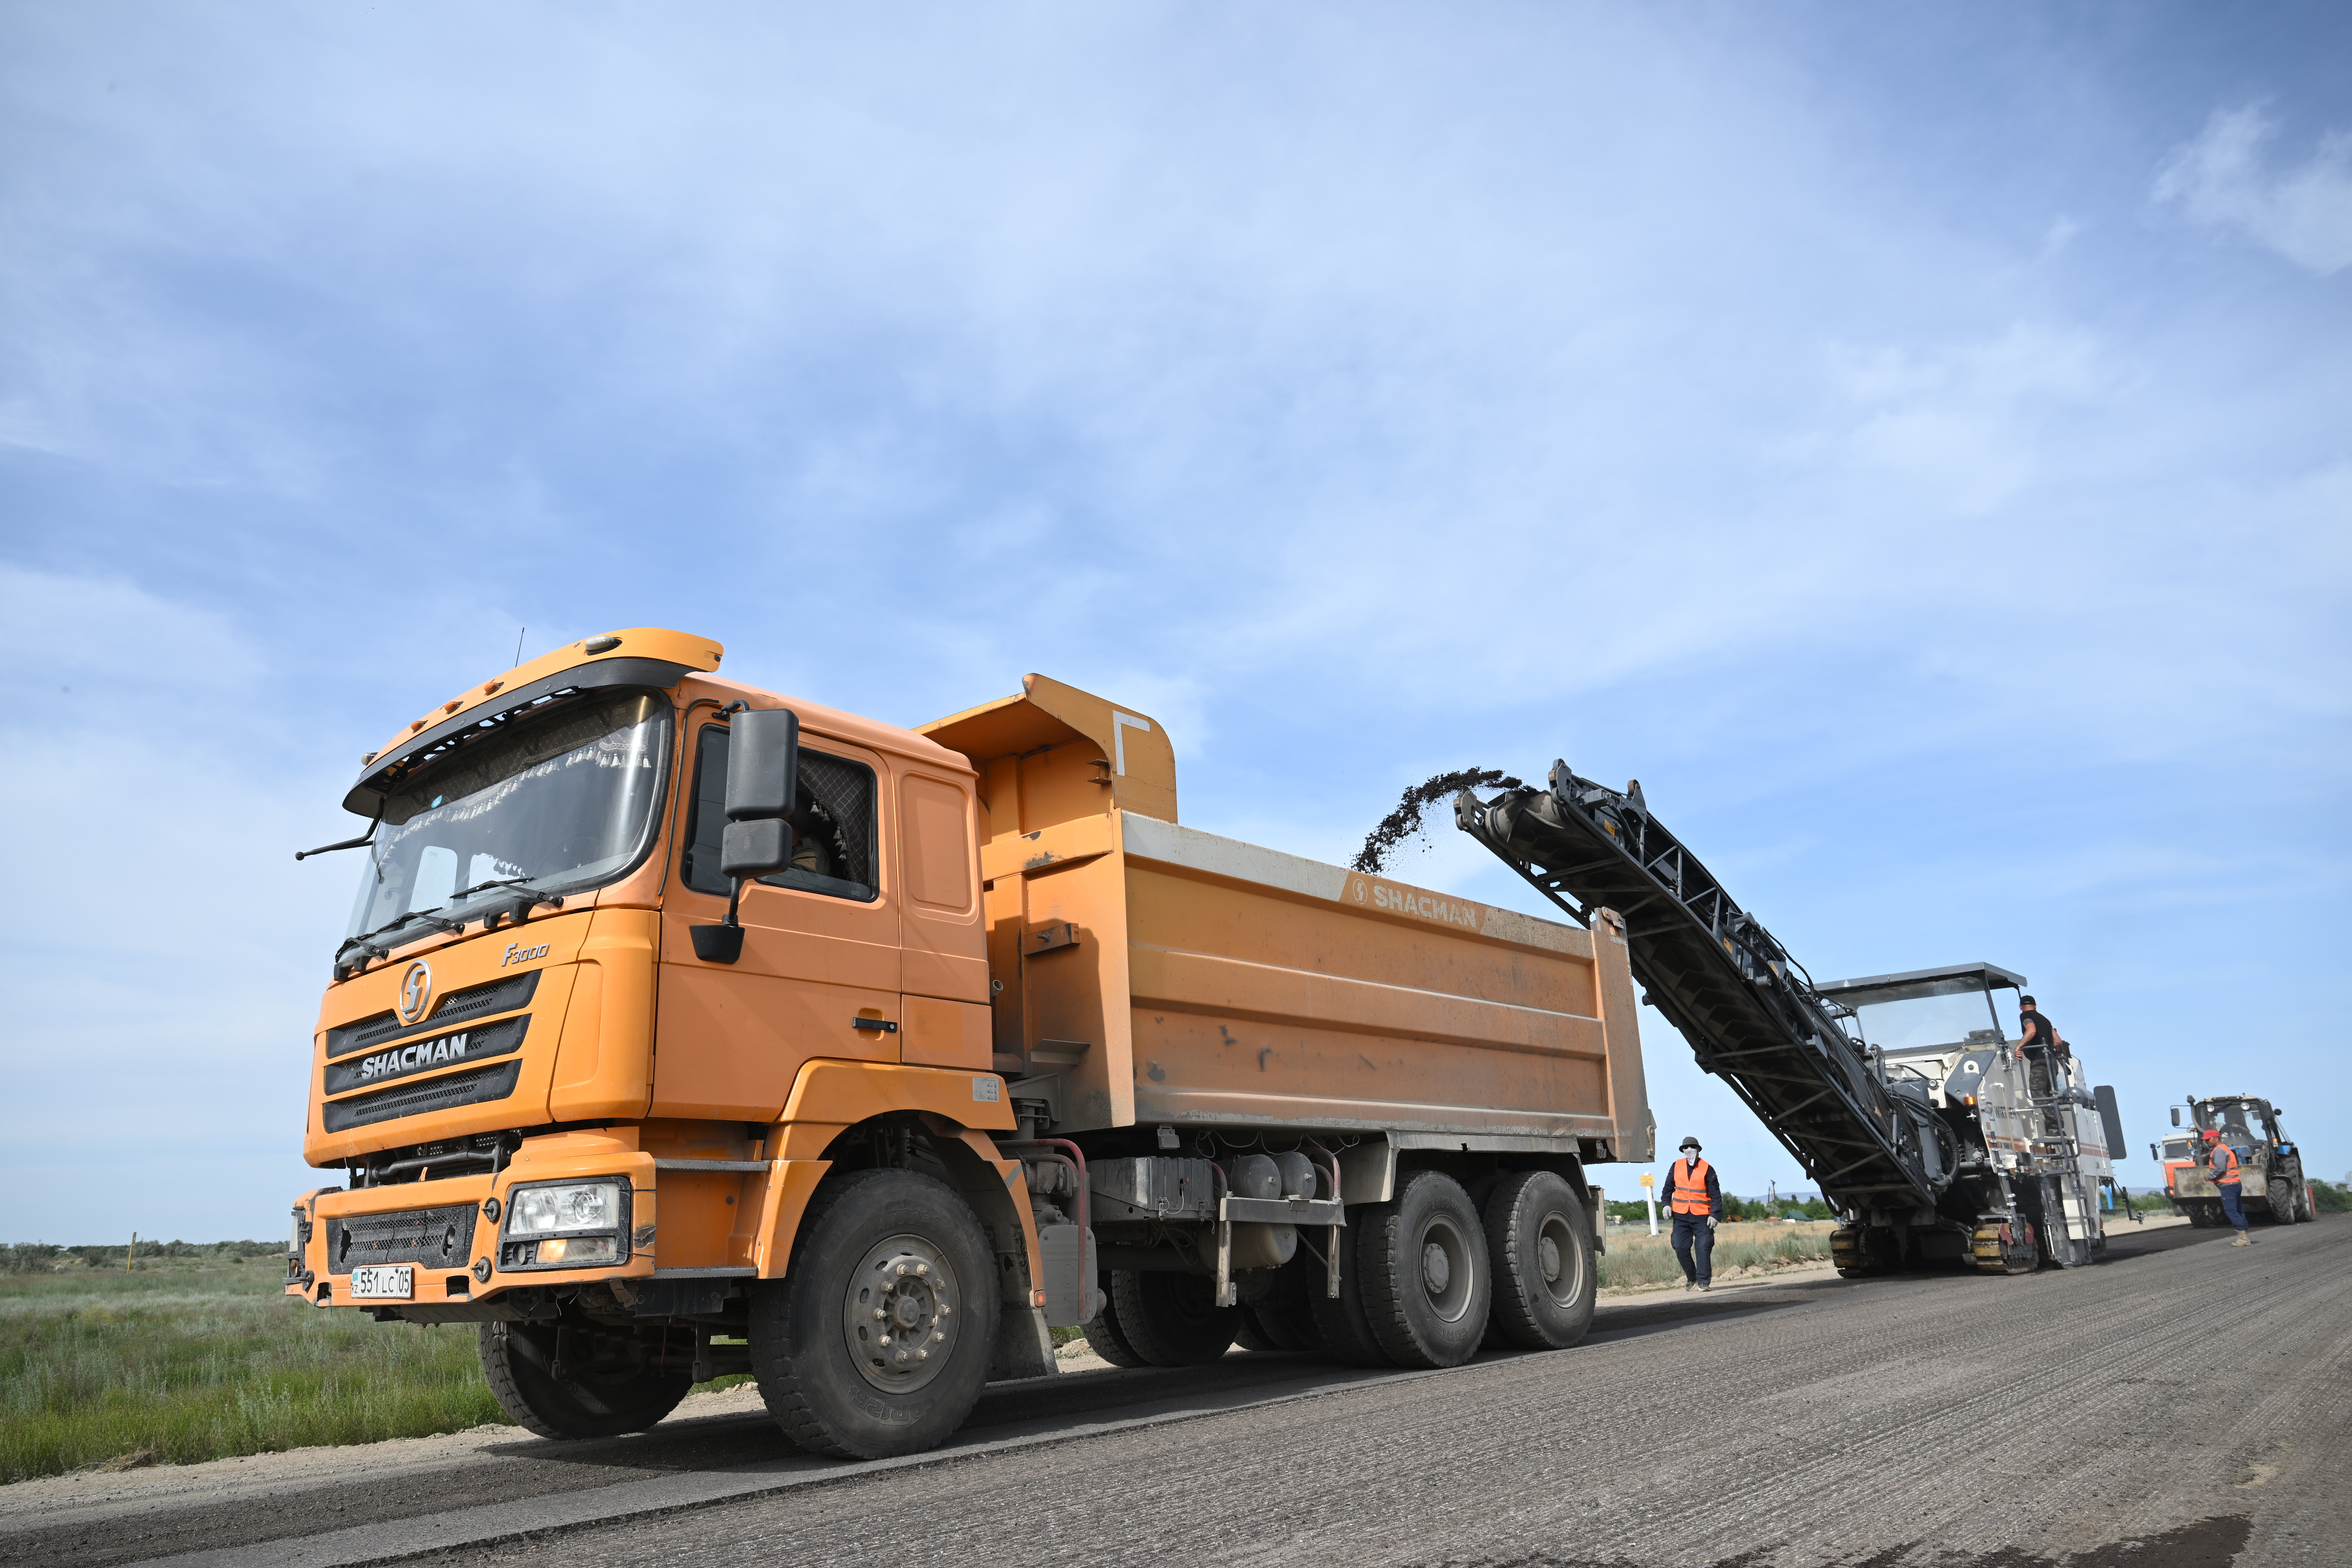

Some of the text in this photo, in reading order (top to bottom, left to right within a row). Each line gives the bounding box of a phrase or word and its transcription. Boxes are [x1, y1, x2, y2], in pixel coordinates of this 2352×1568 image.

[1373, 885, 1476, 928] SHACMAN
[501, 942, 550, 967] F3000
[361, 1033, 468, 1080] SHACMAN
[1994, 1106, 2017, 1120] WIRTEN
[862, 1210, 970, 1260] CARGOPOWER
[361, 1270, 410, 1293] 551 LC 05
